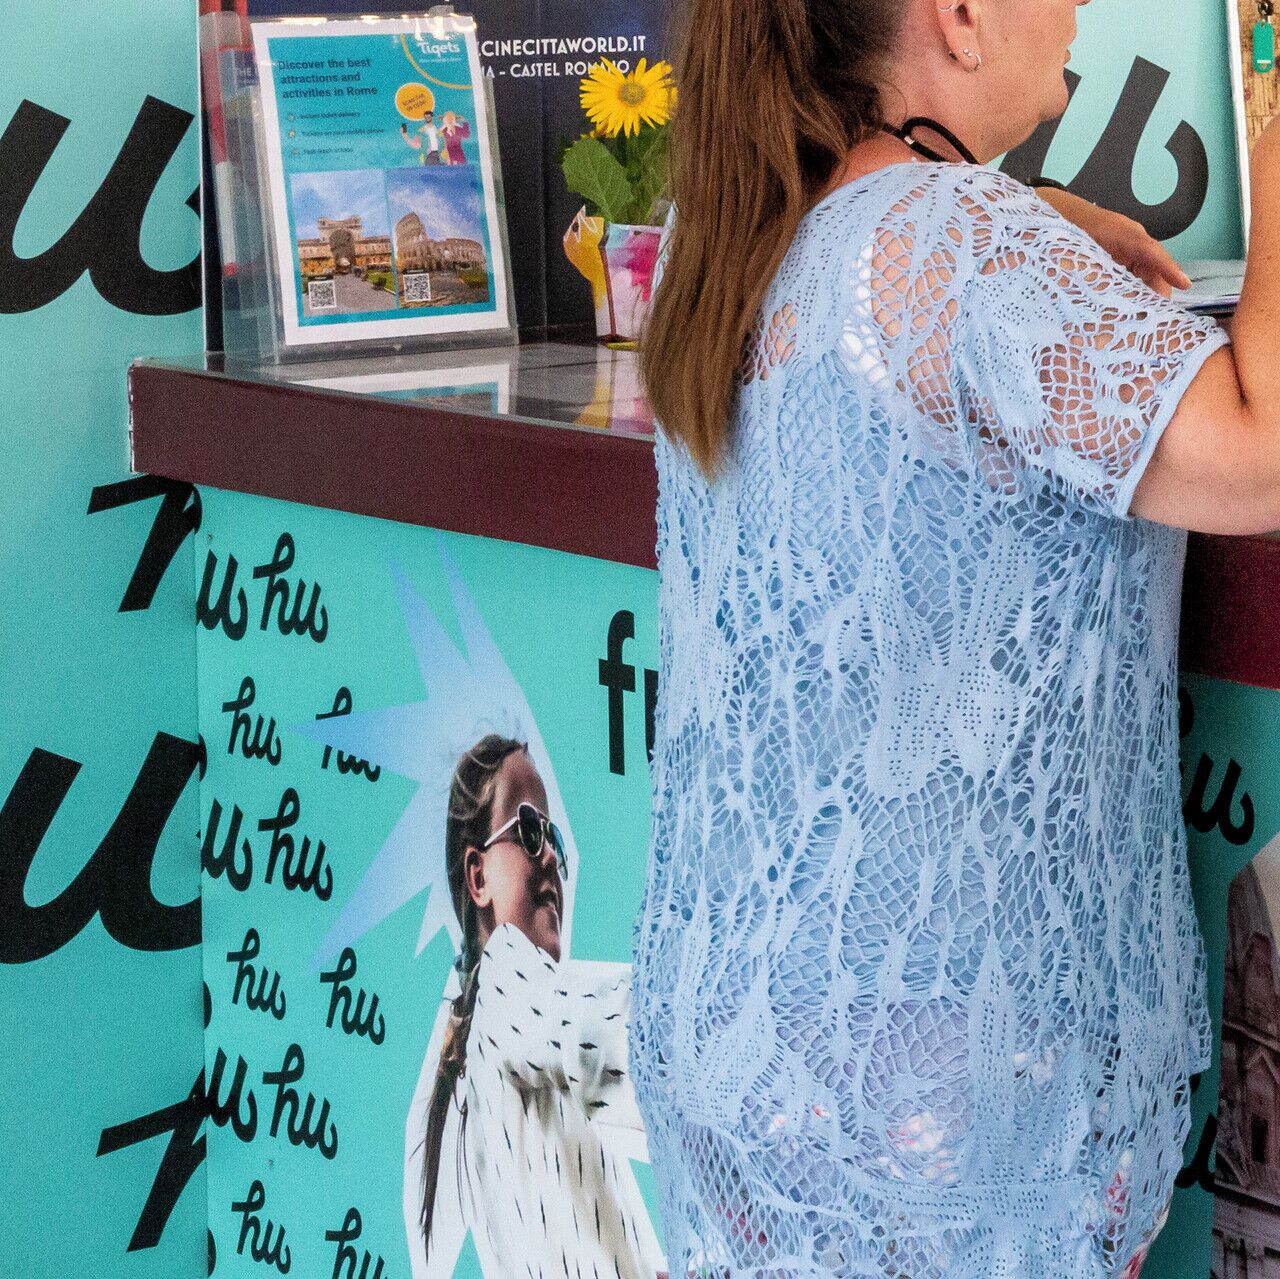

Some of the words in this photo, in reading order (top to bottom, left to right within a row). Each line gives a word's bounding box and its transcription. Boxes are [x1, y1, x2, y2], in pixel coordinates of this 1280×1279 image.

[279, 60, 324, 70] Discover
[328, 59, 345, 68] the
[347, 58, 370, 68] best
[417, 42, 461, 58] Tiqets
[477, 35, 647, 58] .CINECITTAWORLD.IT
[510, 62, 560, 78] CASTEL
[564, 59, 630, 76] ROO
[281, 73, 338, 84] attractions
[341, 72, 361, 82] and
[282, 88, 331, 98] activities
[334, 87, 344, 97] in
[347, 86, 378, 96] Rome
[253, 532, 328, 644] hu
[222, 676, 281, 766] hu
[257, 787, 333, 901] hu
[226, 927, 286, 1020] hu
[320, 947, 385, 1046] hu
[262, 1043, 338, 1160] hu
[231, 1179, 291, 1274] hu
